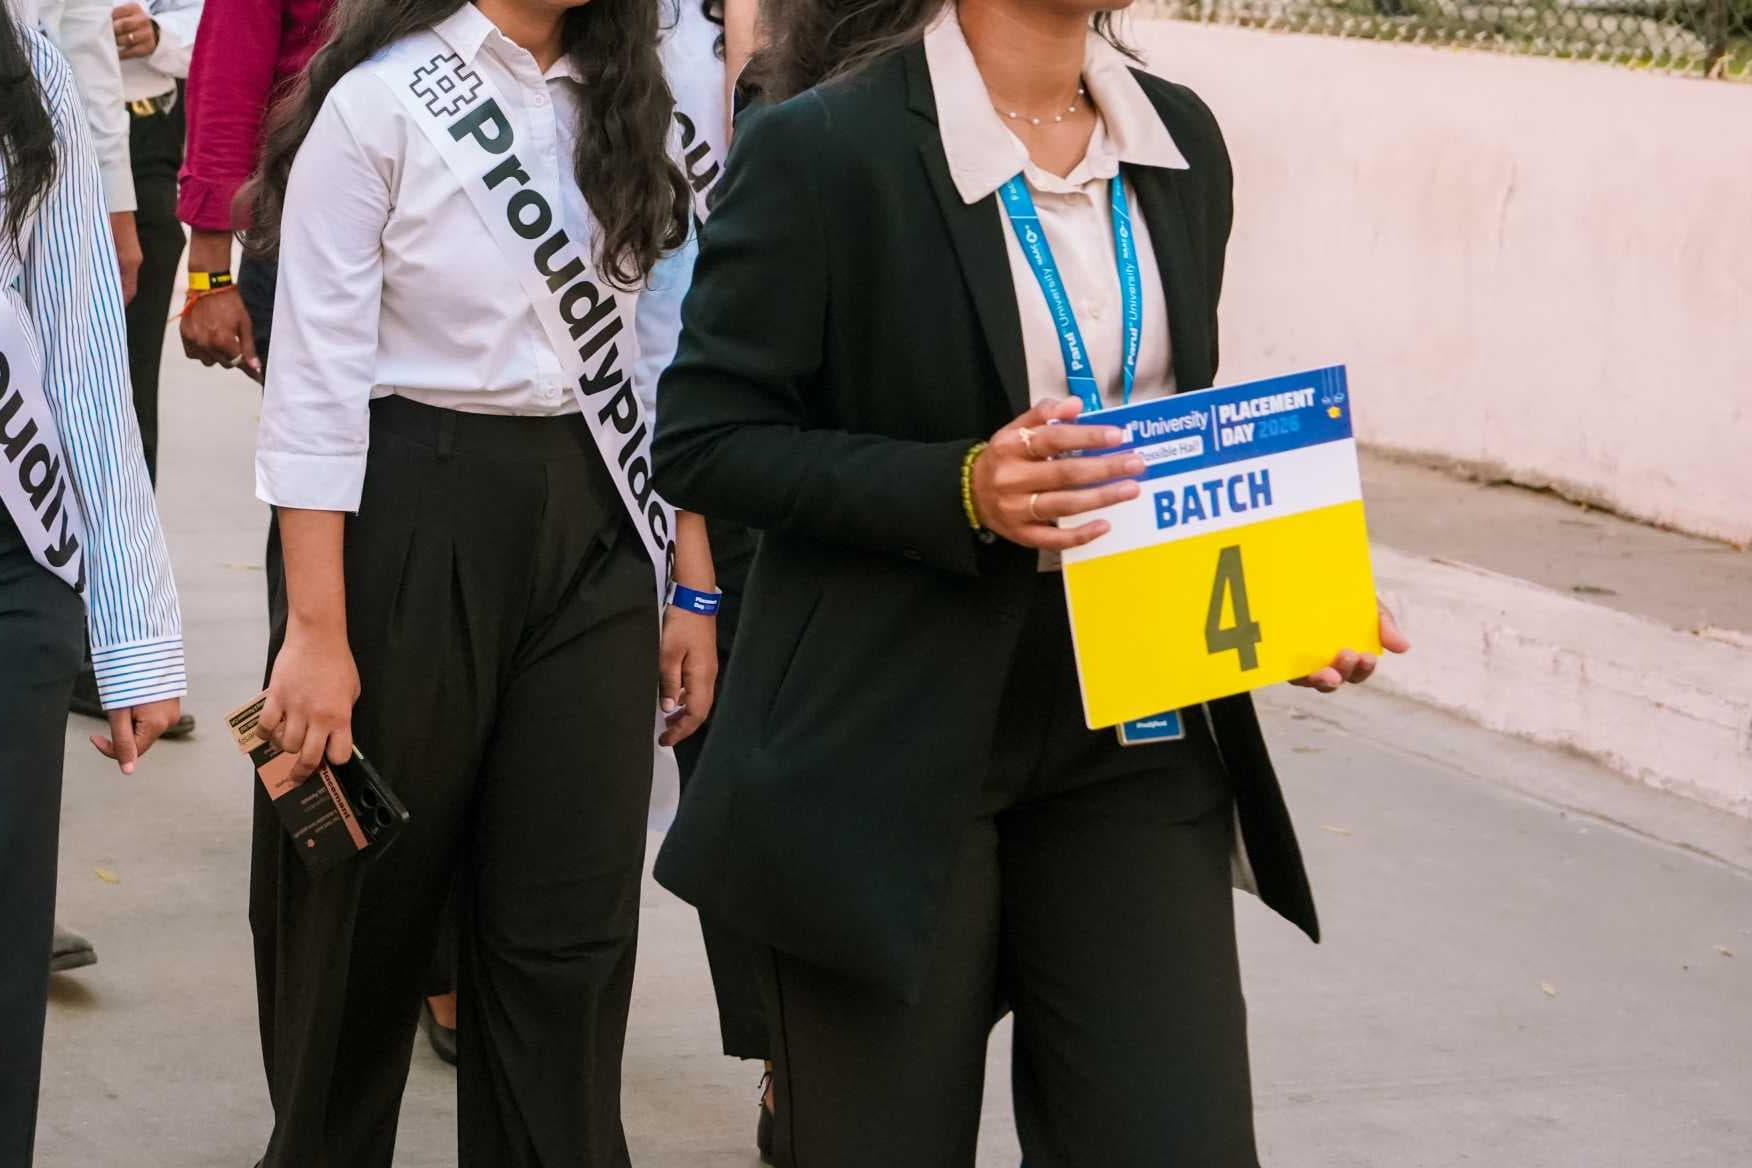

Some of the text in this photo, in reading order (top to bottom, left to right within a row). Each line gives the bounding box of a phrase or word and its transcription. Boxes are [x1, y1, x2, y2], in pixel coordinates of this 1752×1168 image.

[1042, 267, 1070, 327] University
[1125, 263, 1138, 321] University
[1065, 332, 1084, 371] Parul
[1127, 327, 1139, 366] Parul
[1139, 410, 1209, 439] University
[1218, 387, 1316, 424] PLACEMENT
[1220, 423, 1255, 447] DAY
[1153, 468, 1274, 531] BATCH
[1204, 544, 1262, 672] 4
